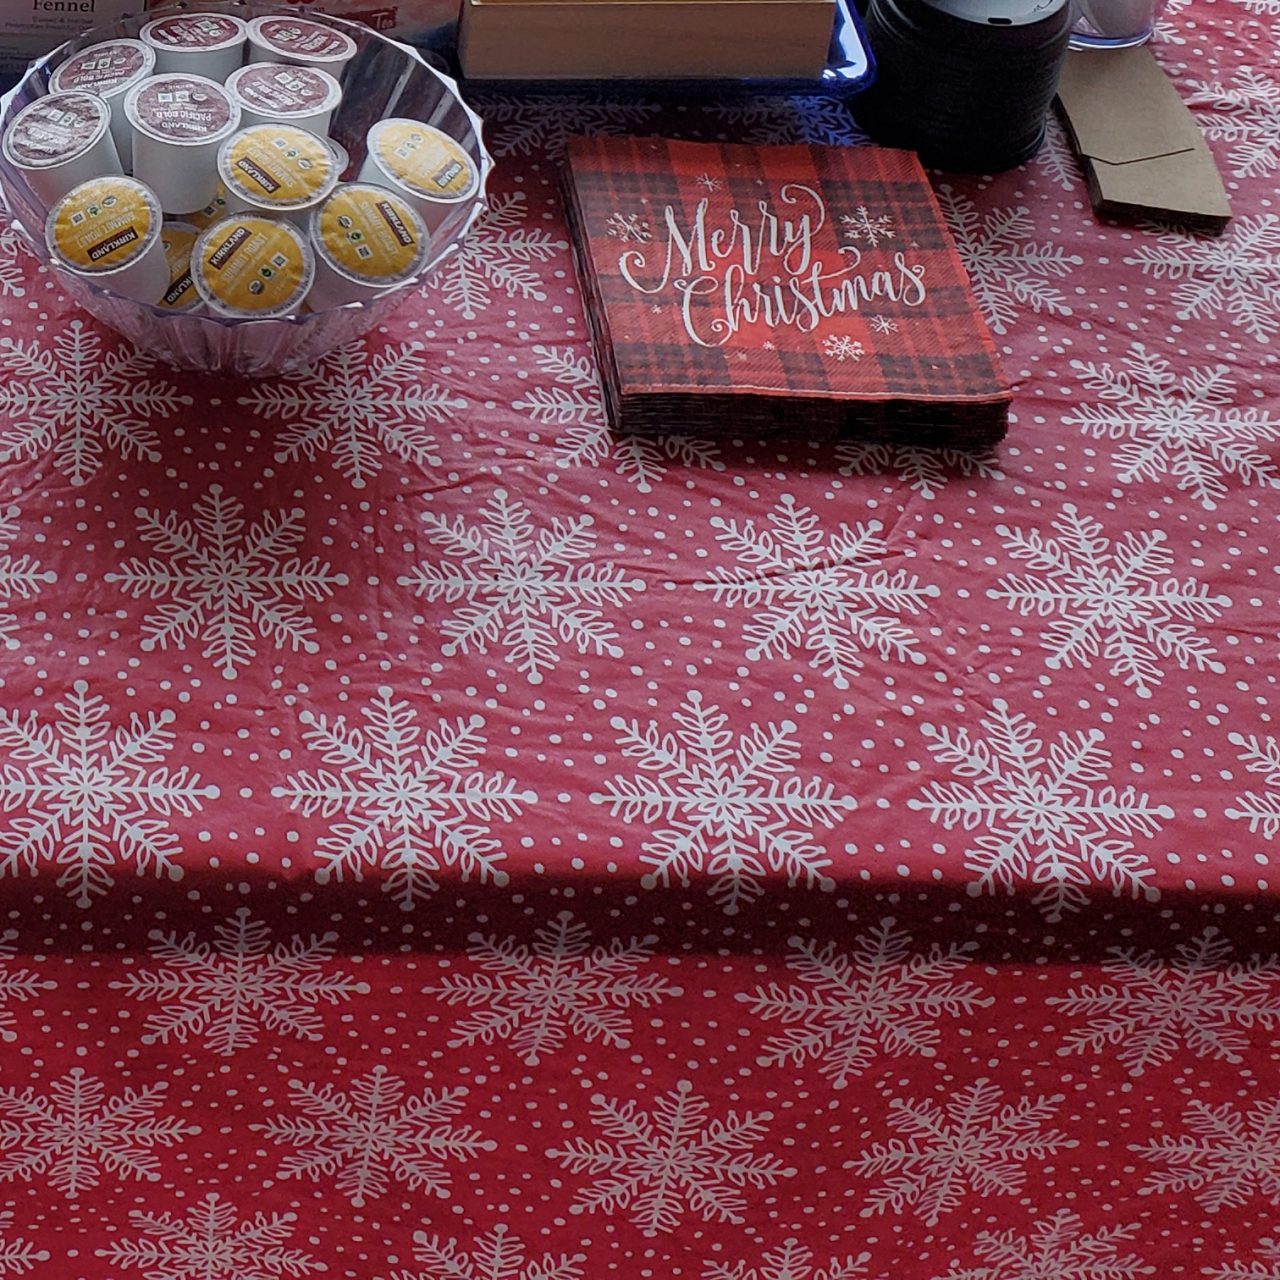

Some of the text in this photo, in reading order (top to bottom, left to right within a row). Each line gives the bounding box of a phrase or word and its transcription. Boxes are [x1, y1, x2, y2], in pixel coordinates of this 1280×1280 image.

[161, 121, 208, 133] KIRKLAND
[179, 111, 212, 122] PACIFIC
[238, 160, 275, 192] KIRKLAND
[381, 202, 412, 244] KIRKLAND
[618, 184, 826, 294] Merry
[91, 231, 136, 260] KIRKLAND
[210, 228, 247, 267] KIRKLAND
[673, 246, 926, 348] Christmas
